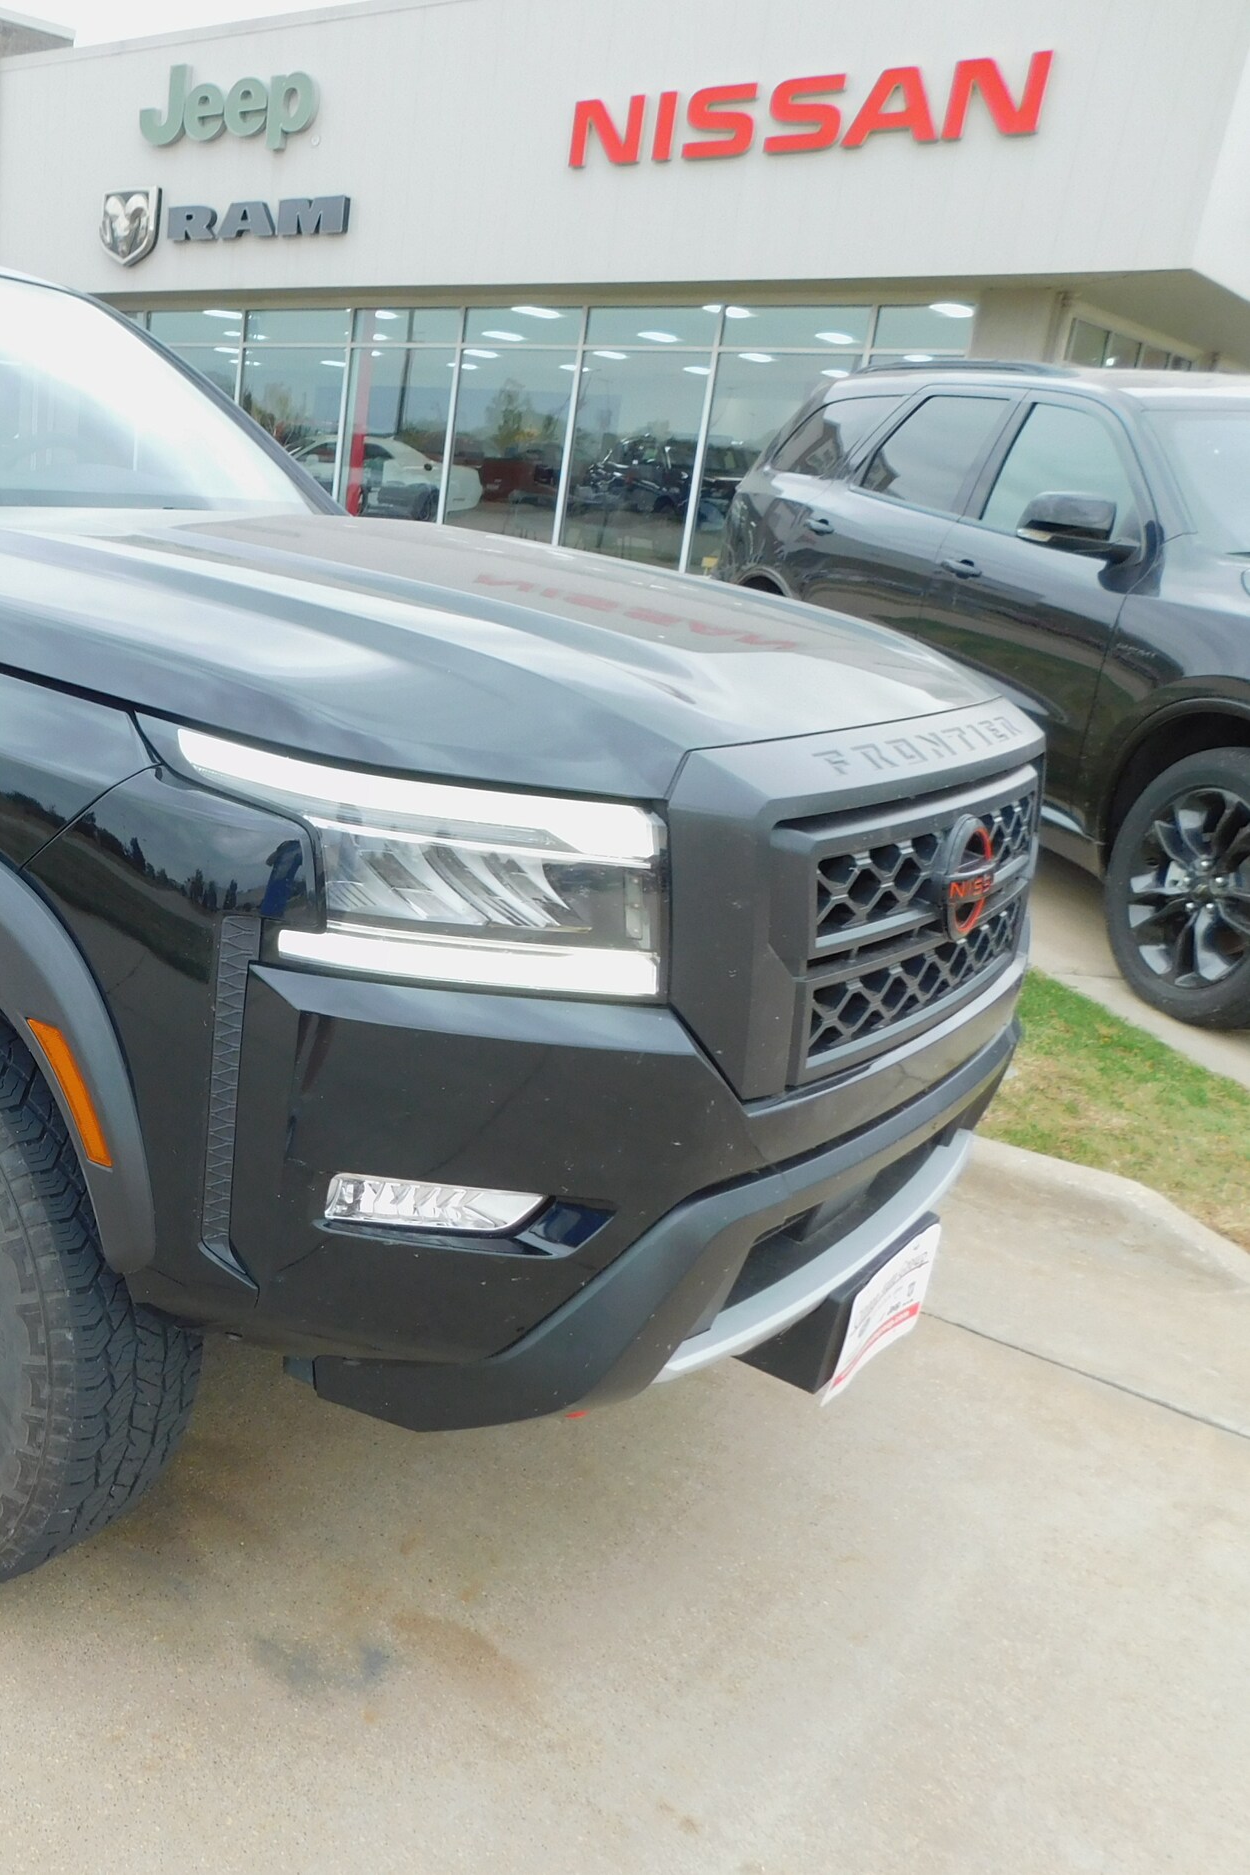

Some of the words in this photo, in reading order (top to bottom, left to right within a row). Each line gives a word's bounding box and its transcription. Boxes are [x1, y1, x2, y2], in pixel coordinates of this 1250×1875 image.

[140, 63, 320, 151] Jeep
[568, 50, 1054, 168] NISSAN
[167, 194, 351, 243] RAM
[811, 716, 1022, 775] FRONTIER
